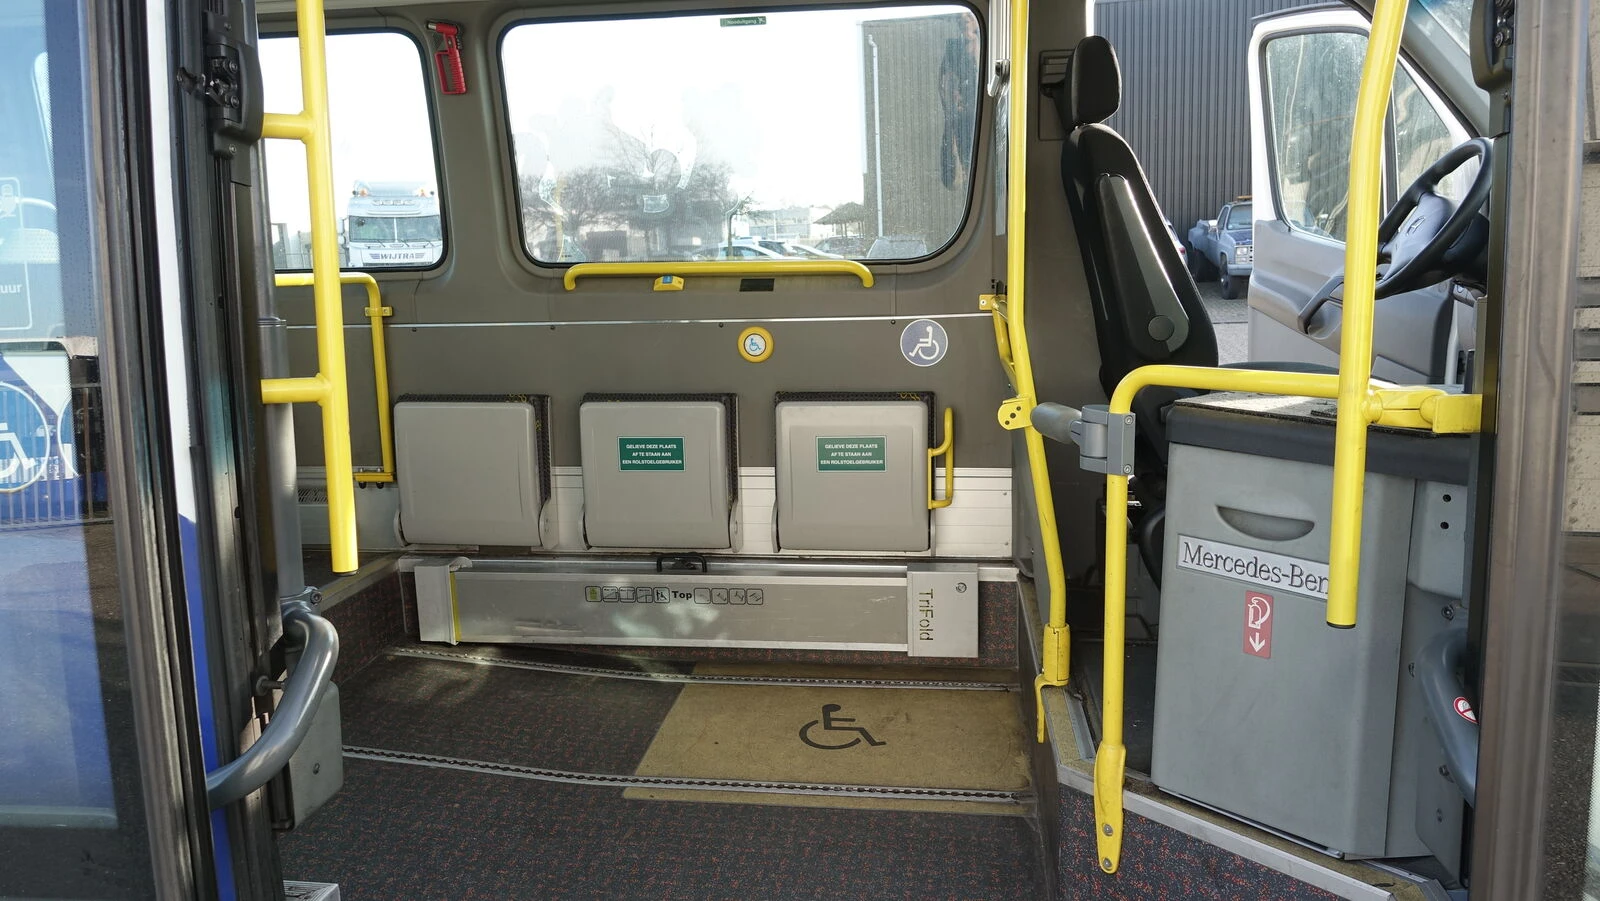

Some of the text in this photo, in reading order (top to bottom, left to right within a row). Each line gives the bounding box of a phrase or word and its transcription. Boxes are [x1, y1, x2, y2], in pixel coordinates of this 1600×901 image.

[1182, 541, 1330, 595] Mercedes-Ben
[672, 591, 693, 599] Top
[919, 588, 934, 641] TriFold
